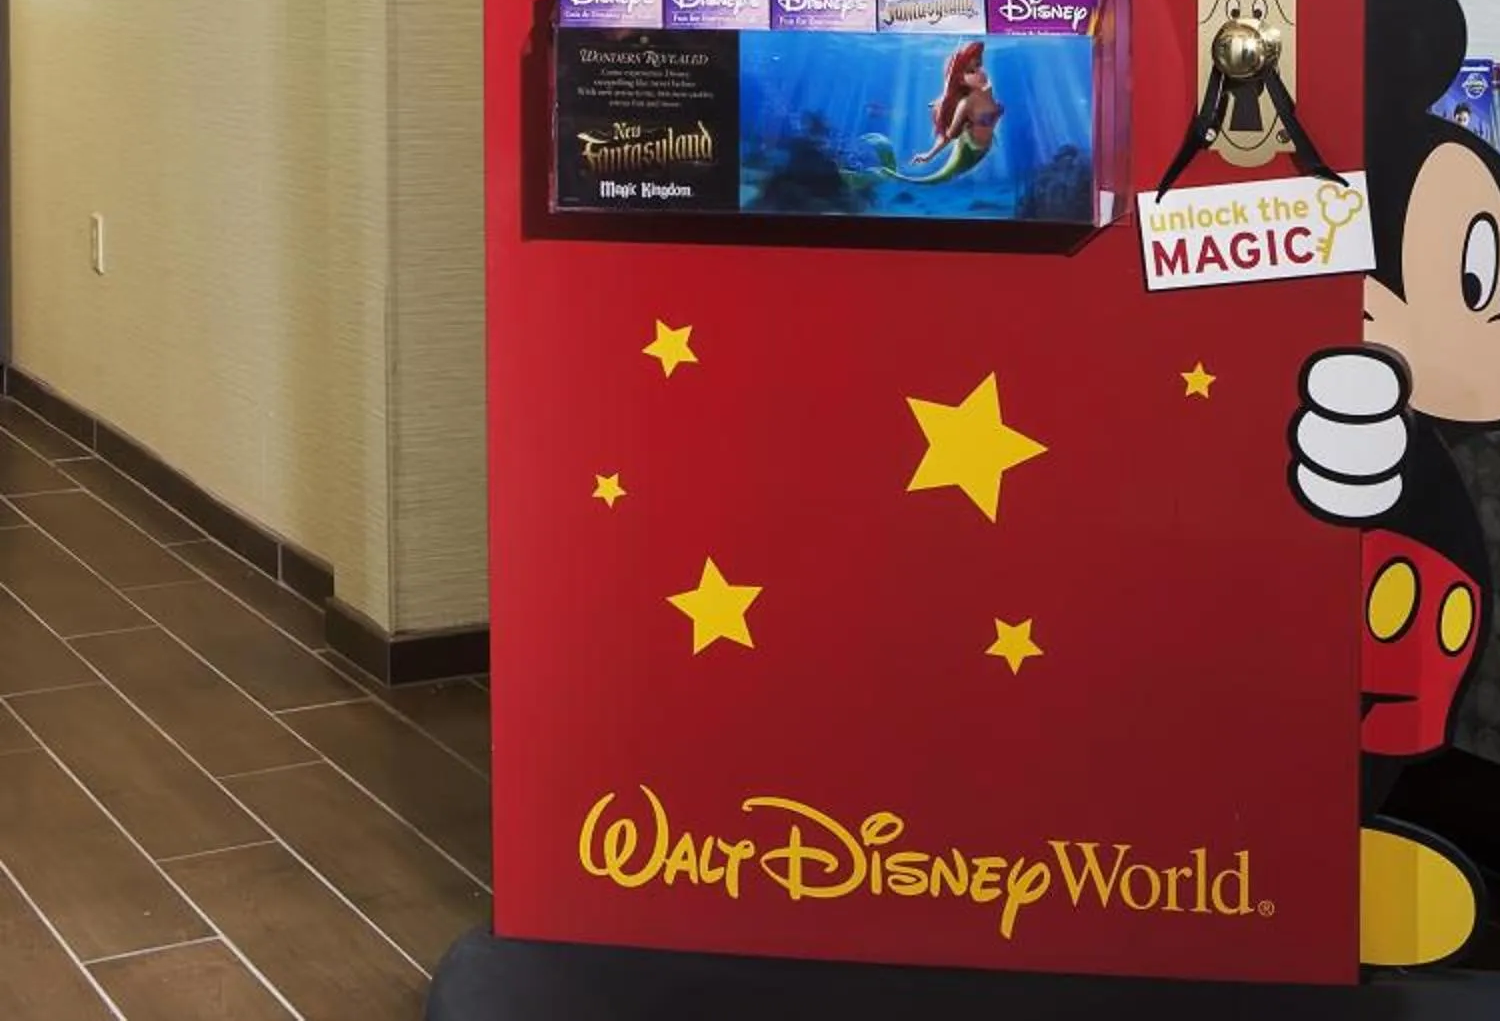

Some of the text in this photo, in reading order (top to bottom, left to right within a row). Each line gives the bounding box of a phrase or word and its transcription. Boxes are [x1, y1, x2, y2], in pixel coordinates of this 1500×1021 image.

[577, 119, 717, 173] Fantasyland
[613, 122, 641, 140] New
[600, 181, 692, 198] Magic Kingdom
[1149, 197, 1309, 232] unlock the
[1151, 227, 1315, 277] MAGIC
[579, 785, 753, 898] Walt
[742, 797, 1050, 939] Disney
